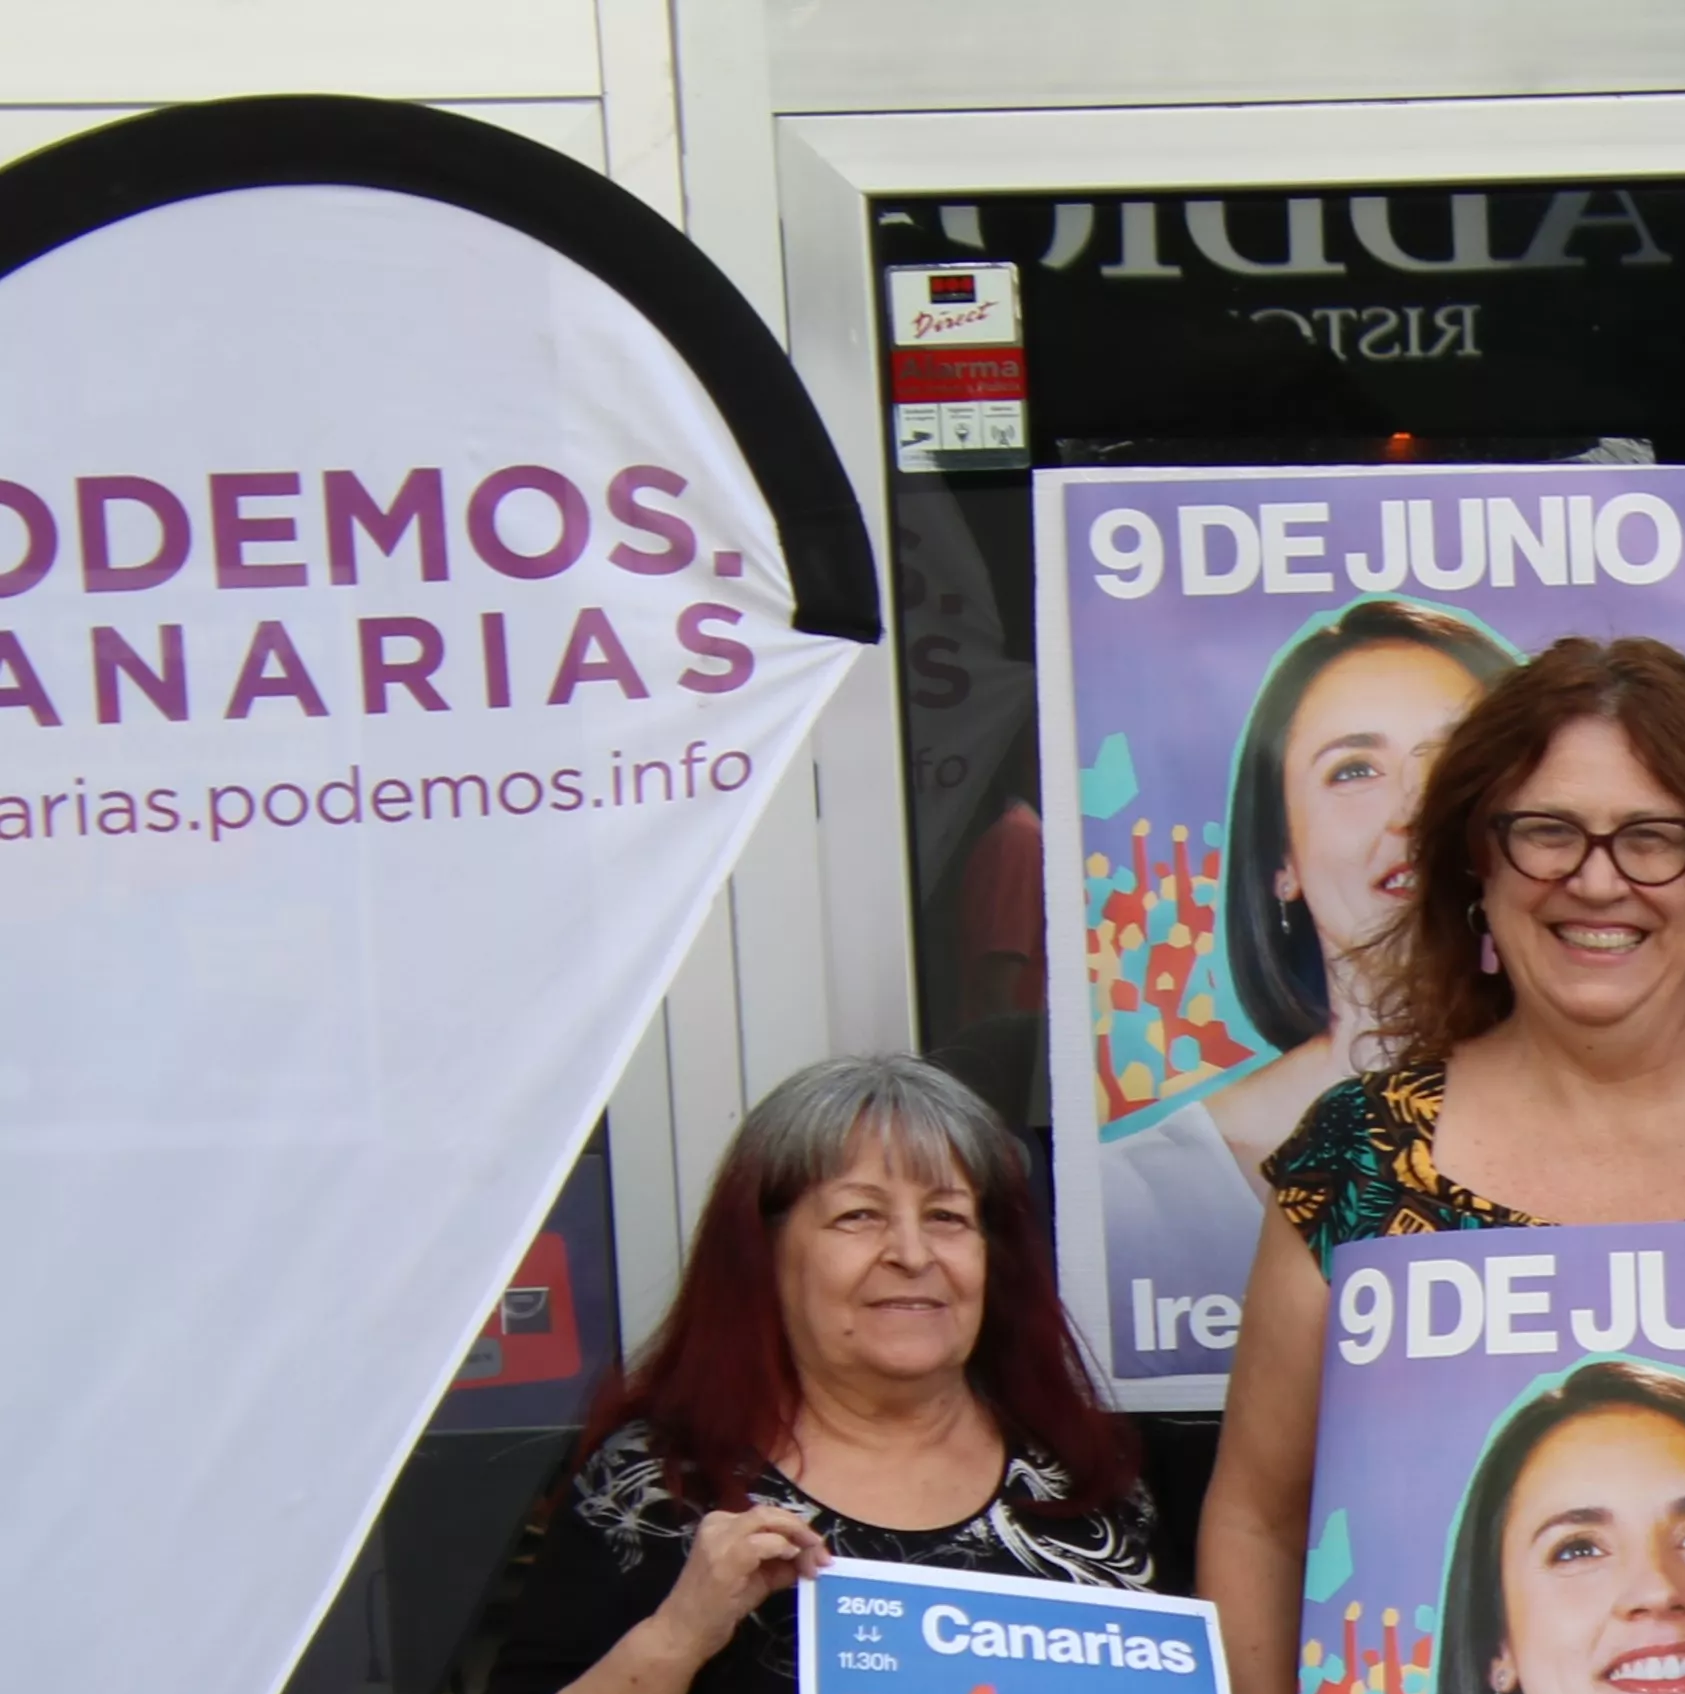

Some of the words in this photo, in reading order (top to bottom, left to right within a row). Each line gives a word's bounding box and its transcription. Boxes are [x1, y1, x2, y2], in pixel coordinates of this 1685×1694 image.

[901, 352, 1020, 380] Alarma
[1089, 508, 1166, 600] 9
[1178, 501, 1335, 595] DE
[1344, 493, 1684, 592] JUNIO
[1131, 1278, 1245, 1351] Ire
[1338, 1268, 1395, 1364] 9
[1405, 1254, 1559, 1359] DE
[837, 1596, 904, 1617] 26/05
[921, 1603, 1197, 1674] Canarias
[837, 1651, 898, 1672] 11.30h
